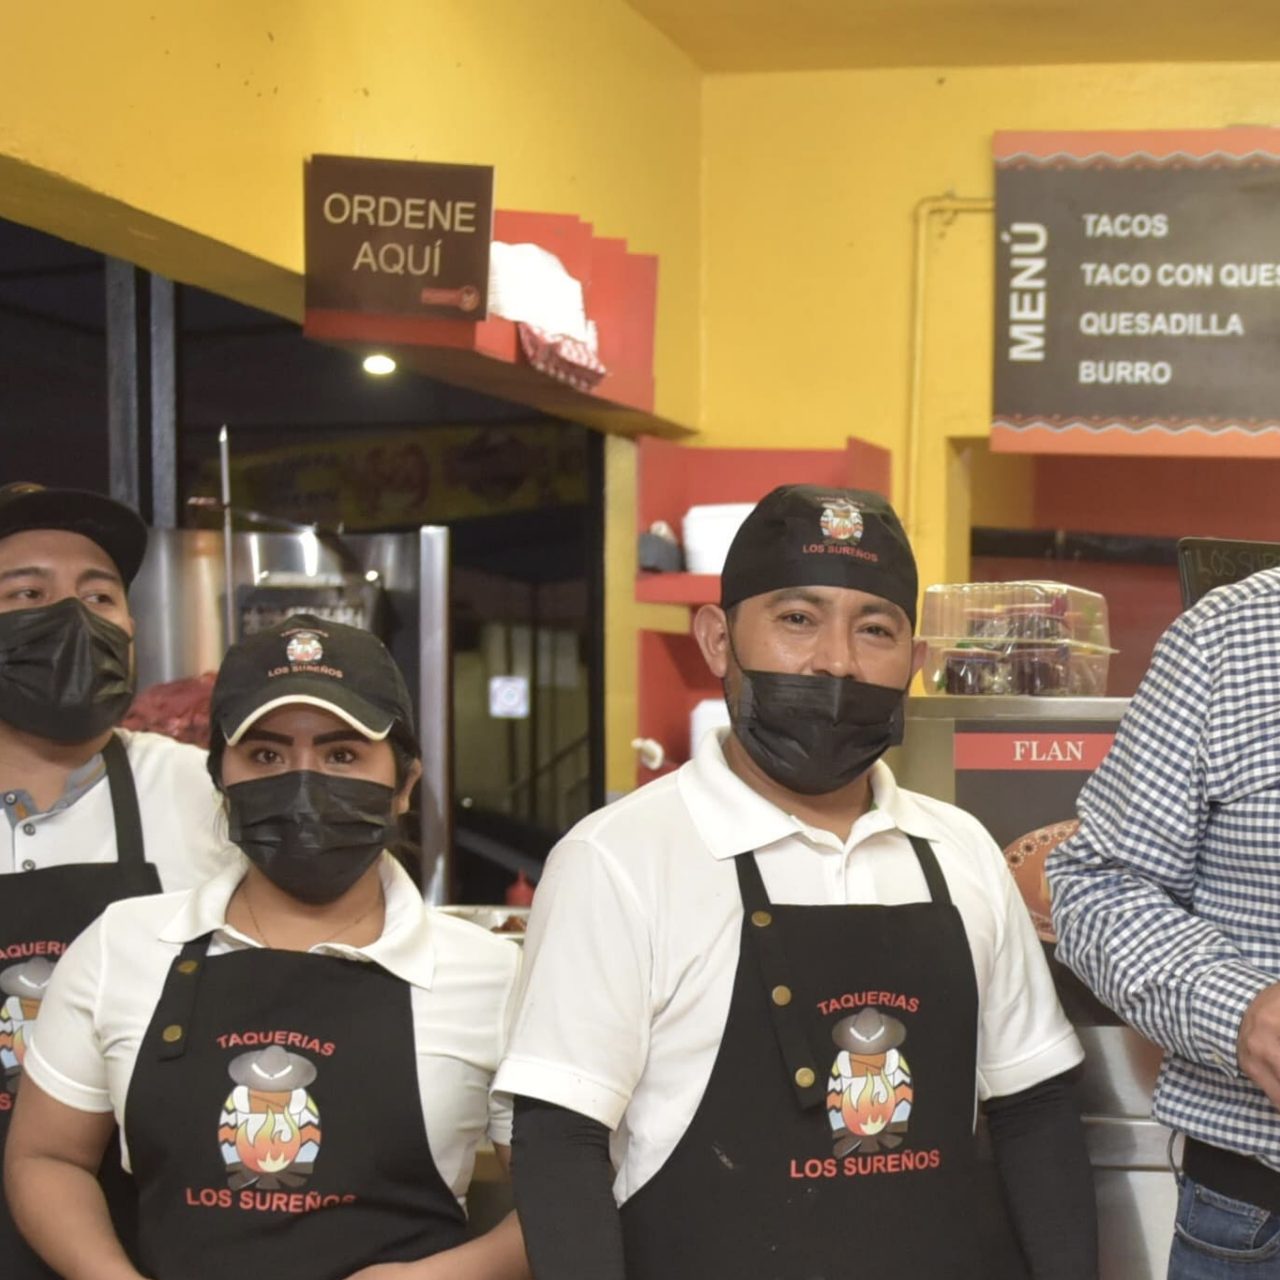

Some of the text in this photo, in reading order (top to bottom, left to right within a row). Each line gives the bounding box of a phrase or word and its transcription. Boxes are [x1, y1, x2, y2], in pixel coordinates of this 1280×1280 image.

[323, 192, 477, 233] ORDENE
[1083, 213, 1169, 239] TACOS
[352, 239, 443, 277] AQUÍ
[1082, 264, 1150, 287] TACO
[1156, 264, 1213, 287] CON
[1001, 221, 1048, 362] MENÚ
[1080, 312, 1244, 337] QUESADILLA
[1079, 362, 1172, 385] BURRO
[803, 543, 825, 554] LOS
[1013, 740, 1084, 762] FLAN
[817, 990, 920, 1015] TAQUERIAS
[216, 1030, 336, 1057] TAQUERIAS
[790, 1149, 941, 1178] LOS SUREÑOS
[186, 1187, 233, 1208] LOS
